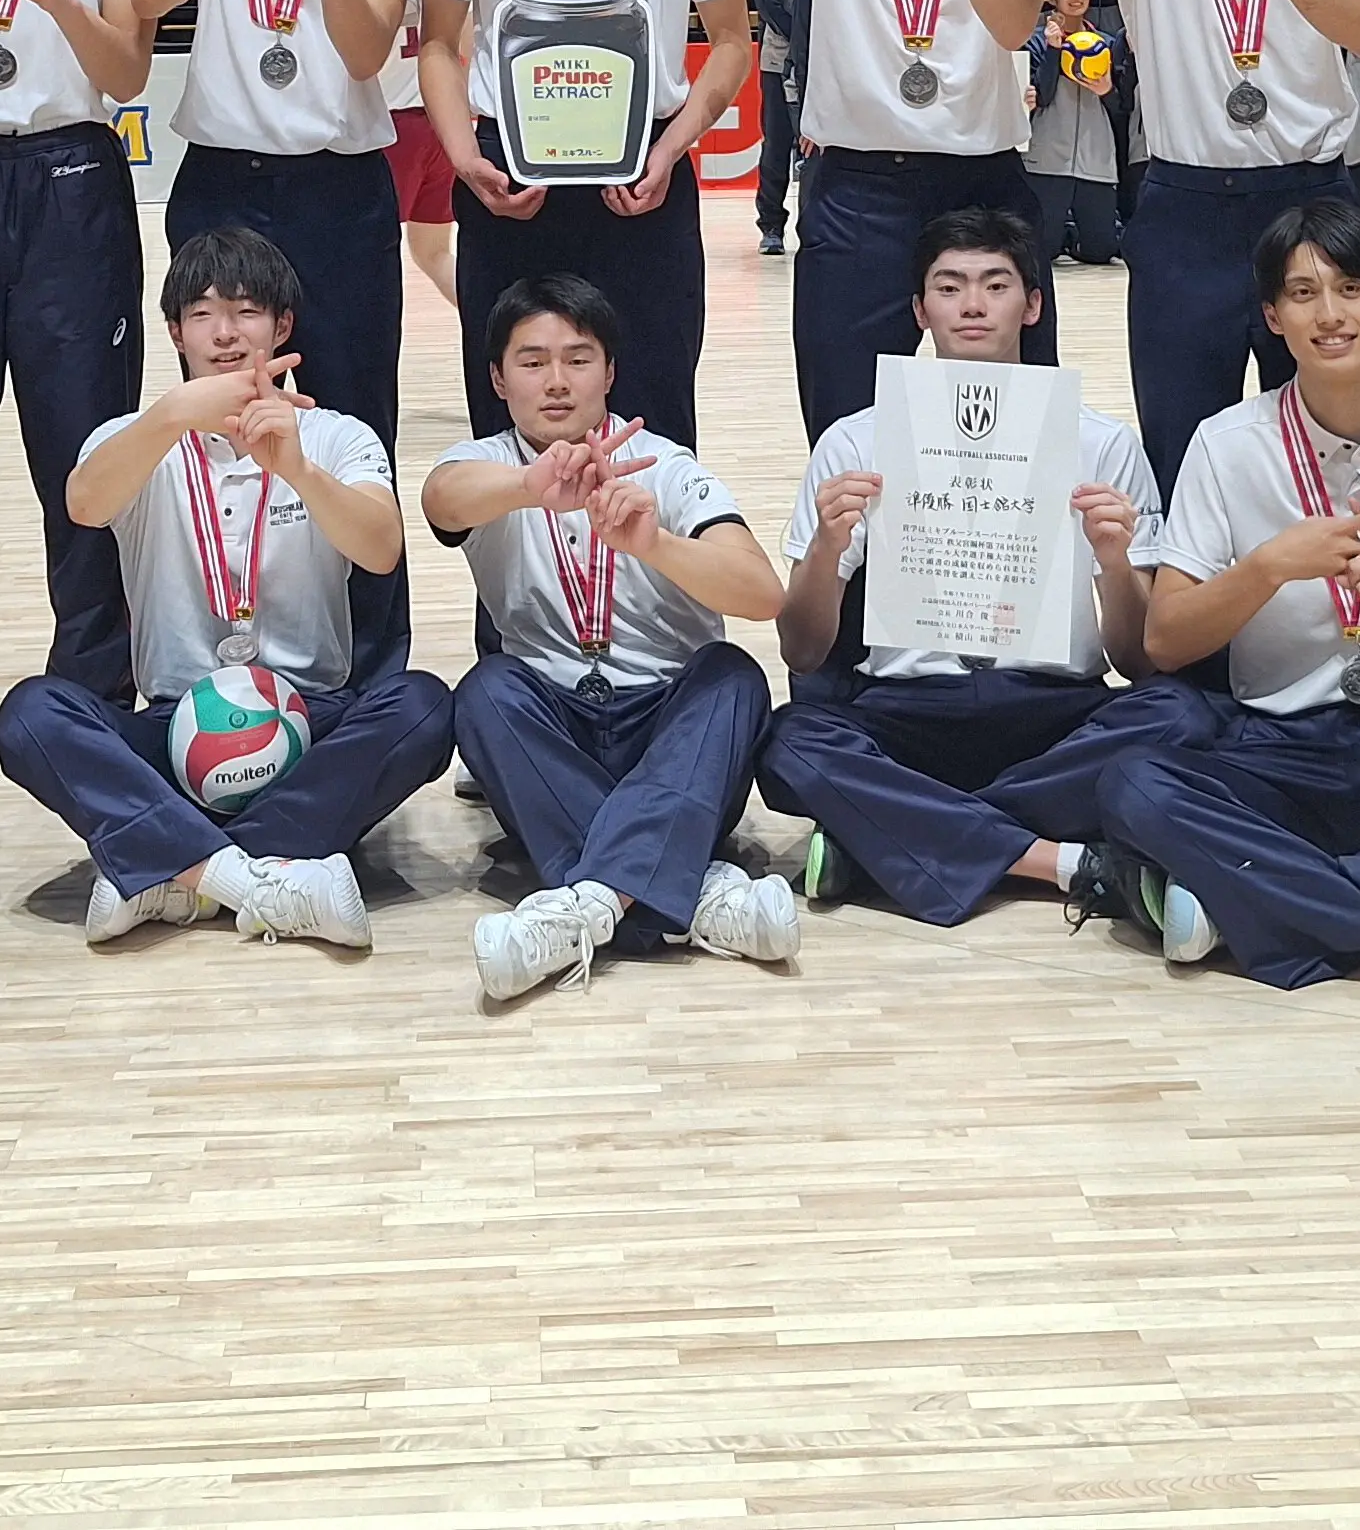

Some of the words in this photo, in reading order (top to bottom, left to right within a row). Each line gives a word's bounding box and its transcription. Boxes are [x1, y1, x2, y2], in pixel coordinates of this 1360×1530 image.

[553, 59, 591, 70] MIKI
[533, 66, 614, 85] Prune
[533, 86, 614, 100] EXTRACT
[920, 447, 942, 456] JAPAN
[943, 449, 983, 459] VOLLEYBALL
[984, 452, 1028, 463] ASSOCIATION
[215, 761, 277, 784] molten
